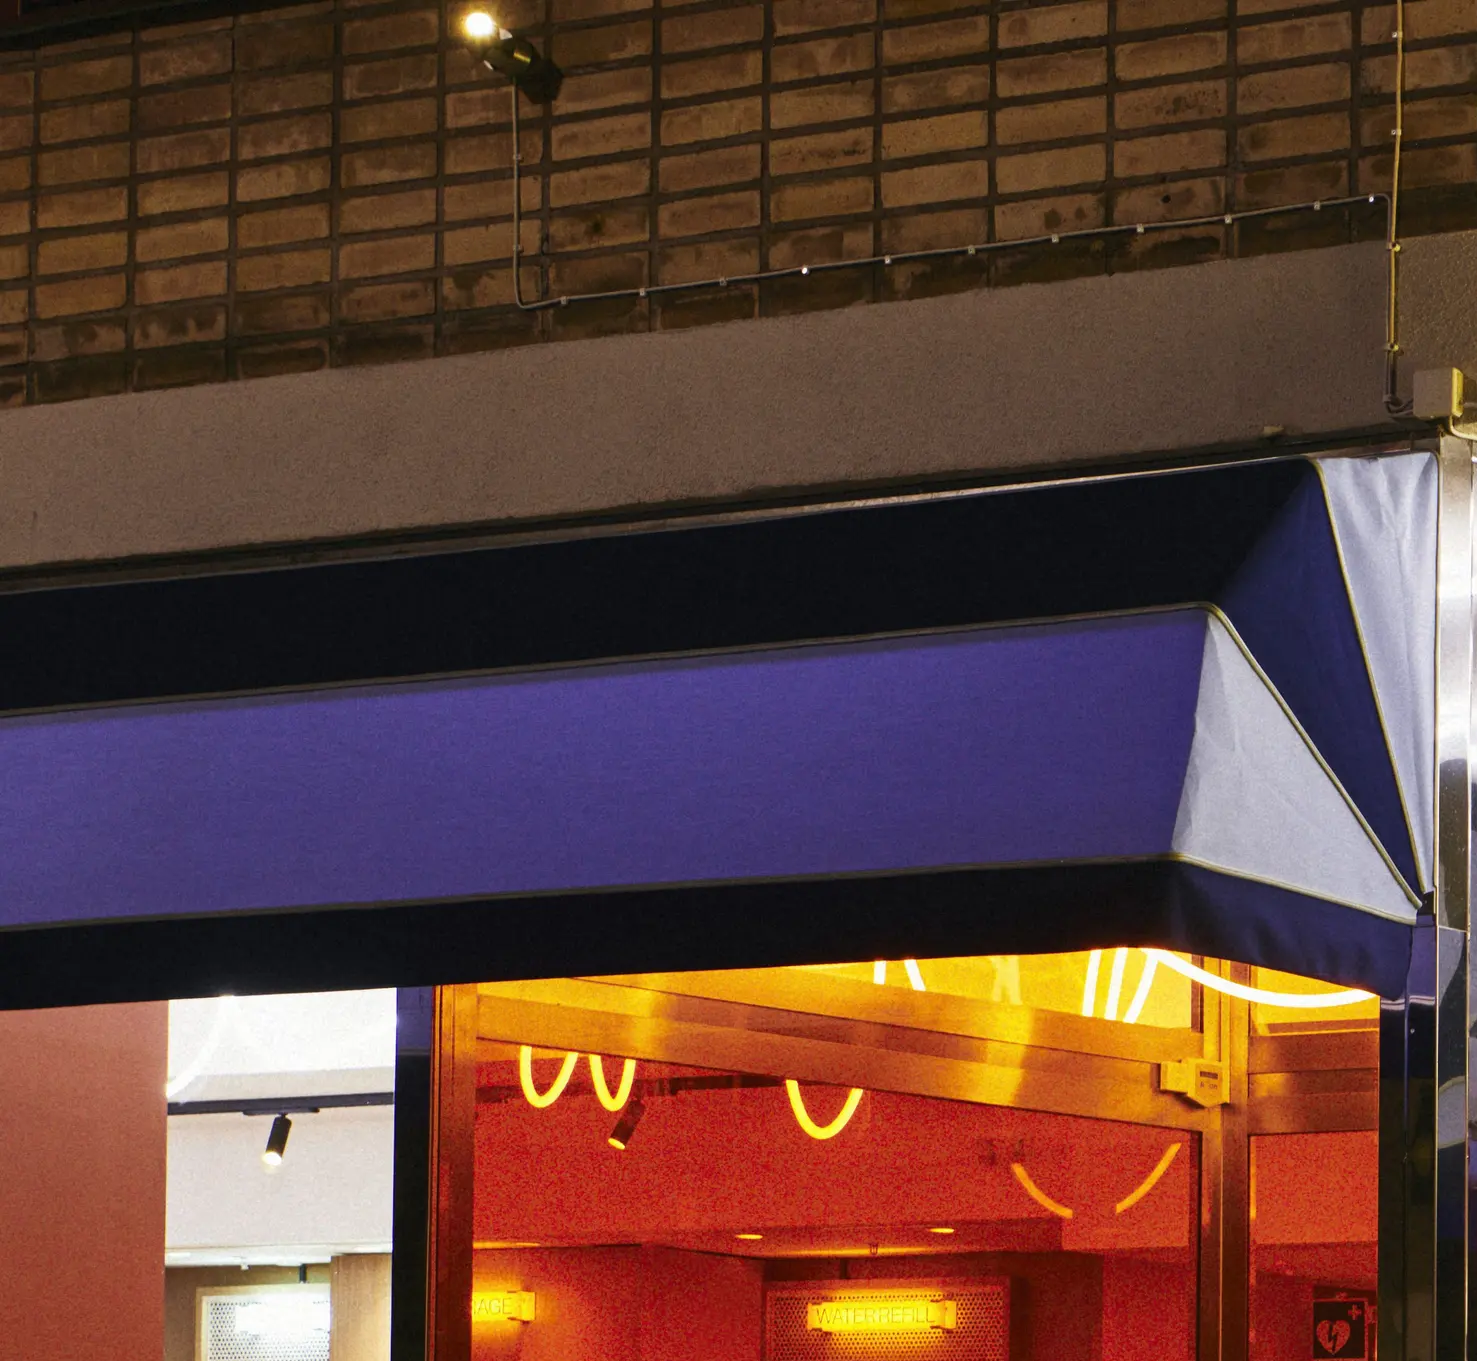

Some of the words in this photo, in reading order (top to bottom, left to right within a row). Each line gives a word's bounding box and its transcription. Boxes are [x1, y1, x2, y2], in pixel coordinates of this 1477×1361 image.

[473, 1297, 513, 1316] AGE
[816, 1307, 875, 1325] WATER
[878, 1306, 936, 1324] REFILL
